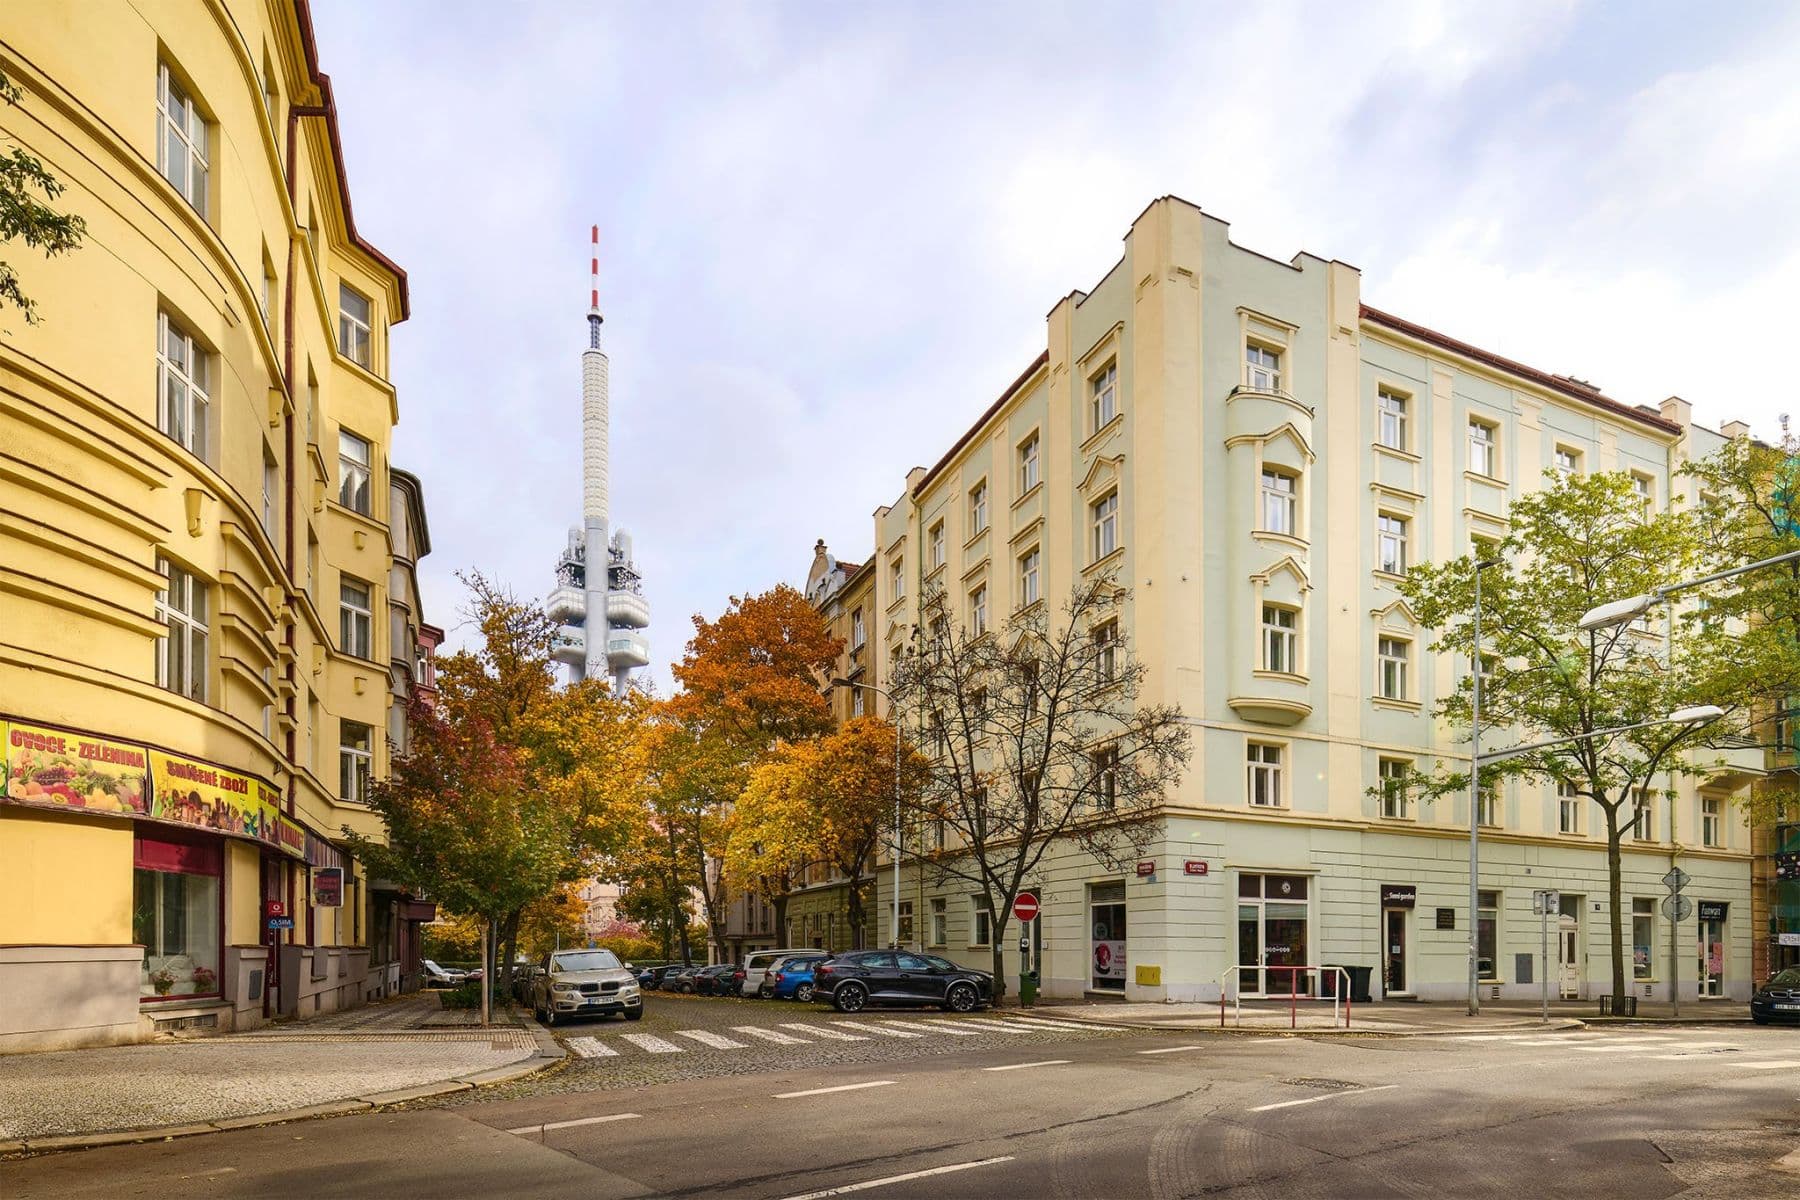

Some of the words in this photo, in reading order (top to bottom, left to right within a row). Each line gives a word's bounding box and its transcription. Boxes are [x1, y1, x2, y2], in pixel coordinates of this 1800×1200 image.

[10, 729, 67, 755] OVOCE
[78, 741, 146, 768] ZELENINA
[166, 760, 218, 787] SMÍŠENÉ
[219, 774, 248, 795] ZBOŽÍ
